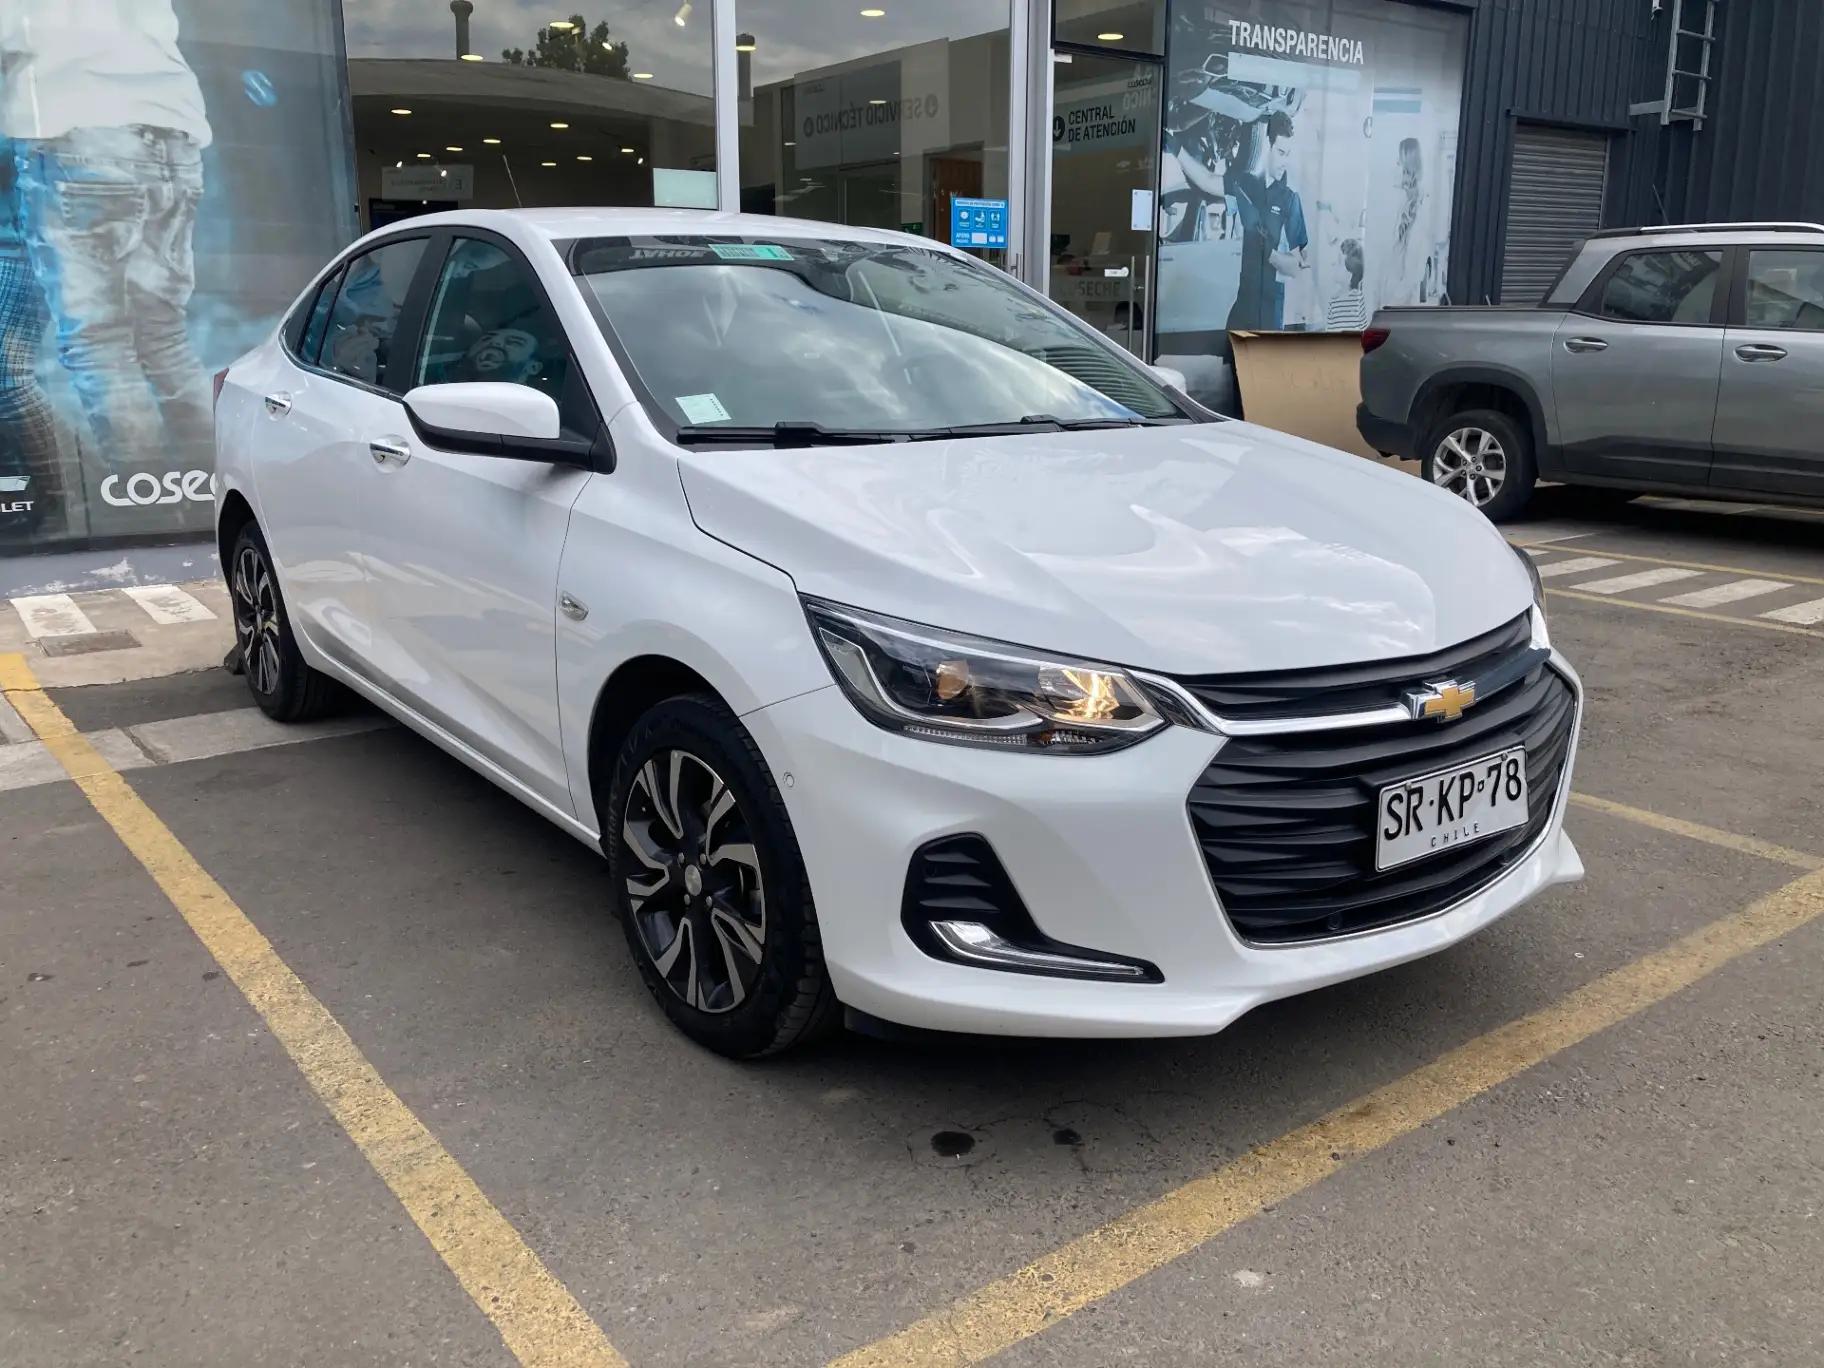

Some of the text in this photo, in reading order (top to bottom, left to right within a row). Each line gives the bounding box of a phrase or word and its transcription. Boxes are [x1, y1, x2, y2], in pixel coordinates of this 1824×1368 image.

[1228, 19, 1364, 65] TRANSPARENCIA
[1068, 104, 1115, 126] CENTRAL
[1068, 116, 1136, 142] DE ATENCIÓN
[1075, 281, 1121, 299] SECHE
[101, 470, 216, 507] cose
[0, 500, 34, 513] LET
[1431, 822, 1480, 847] CHILE
